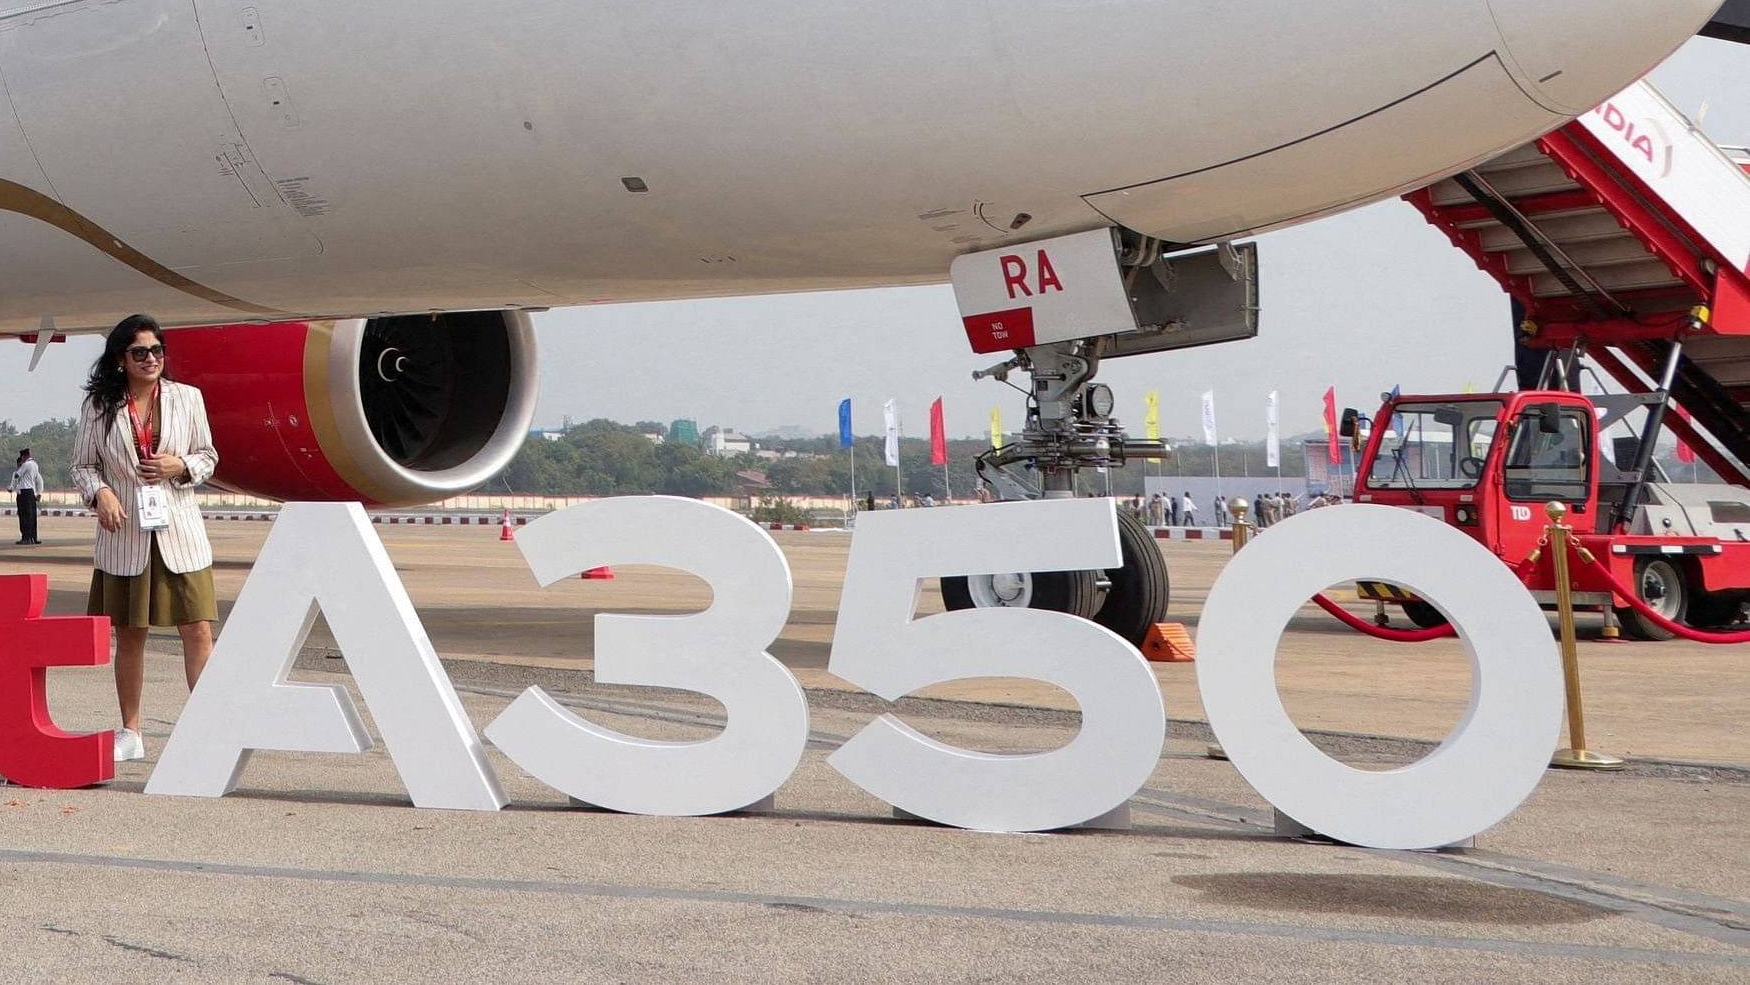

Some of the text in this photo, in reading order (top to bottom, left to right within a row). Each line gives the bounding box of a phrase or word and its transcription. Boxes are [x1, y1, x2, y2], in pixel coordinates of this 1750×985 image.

[999, 248, 1064, 299] RA
[991, 321, 1004, 331] NO
[991, 331, 1009, 340] TOW
[143, 495, 1566, 851] A350
